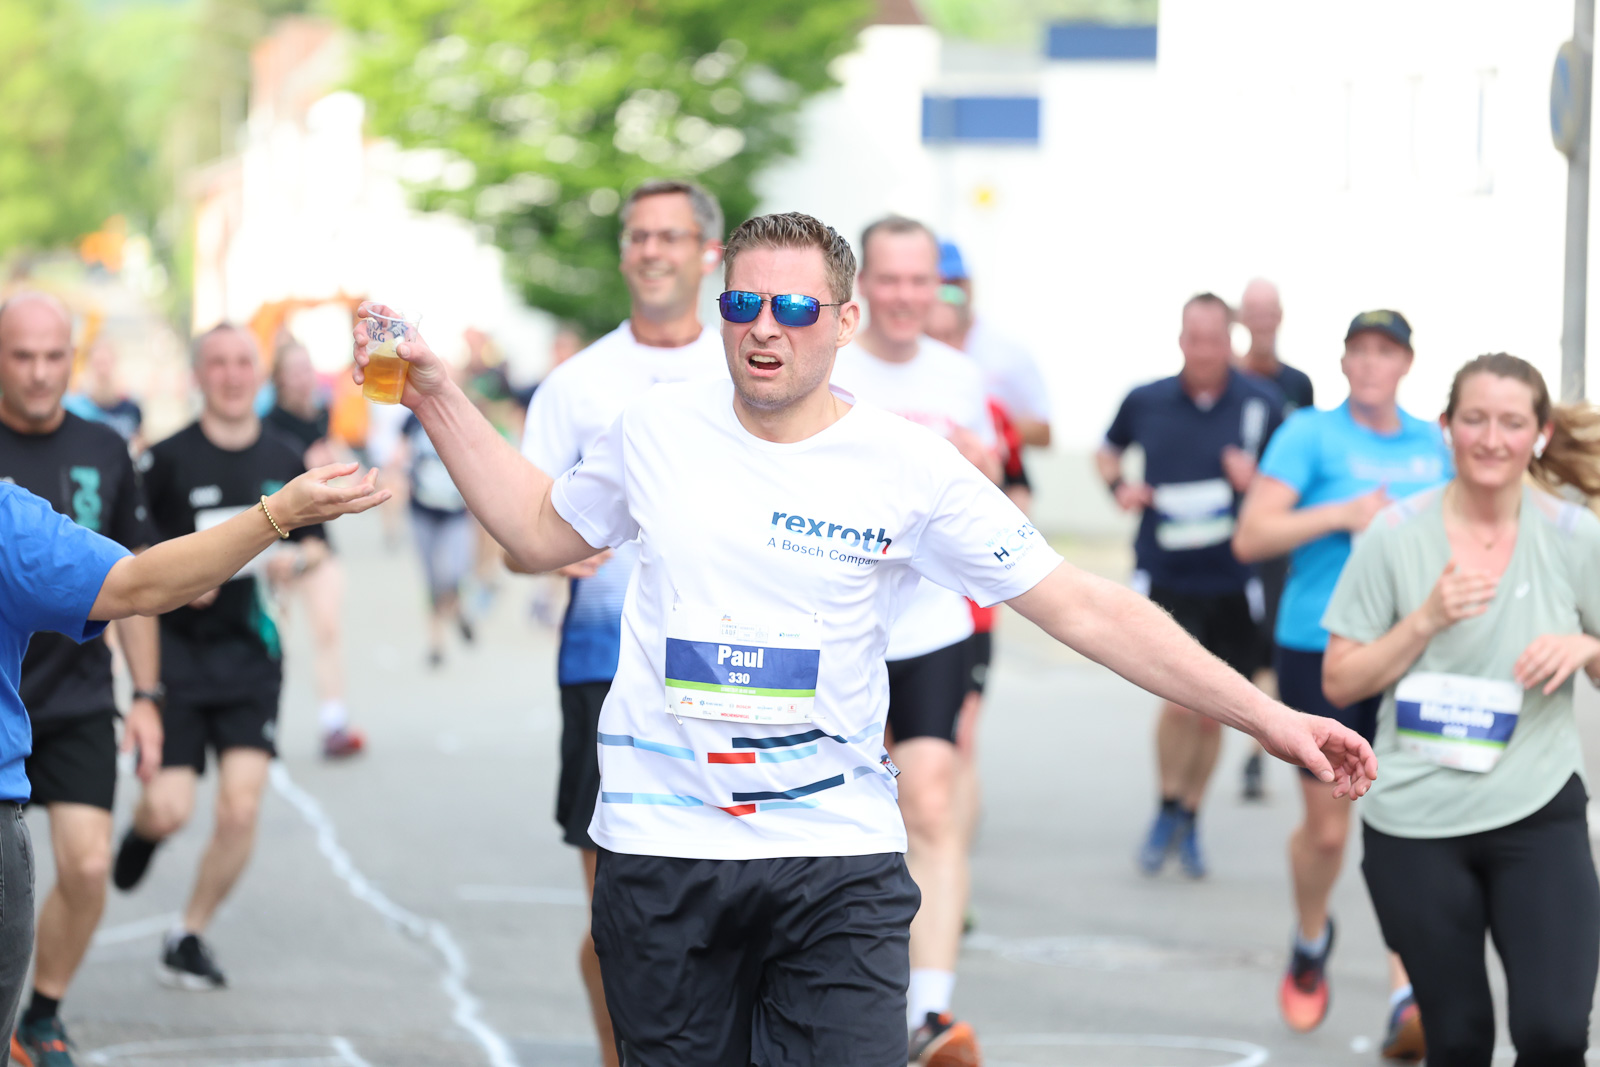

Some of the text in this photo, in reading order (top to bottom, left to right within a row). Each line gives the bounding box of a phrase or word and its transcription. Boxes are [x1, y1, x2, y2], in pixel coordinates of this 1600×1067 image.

[771, 511, 893, 555] rexroth
[767, 537, 777, 548] A
[782, 539, 824, 558] Bosch
[717, 644, 764, 669] Paul
[728, 671, 751, 685] 330
